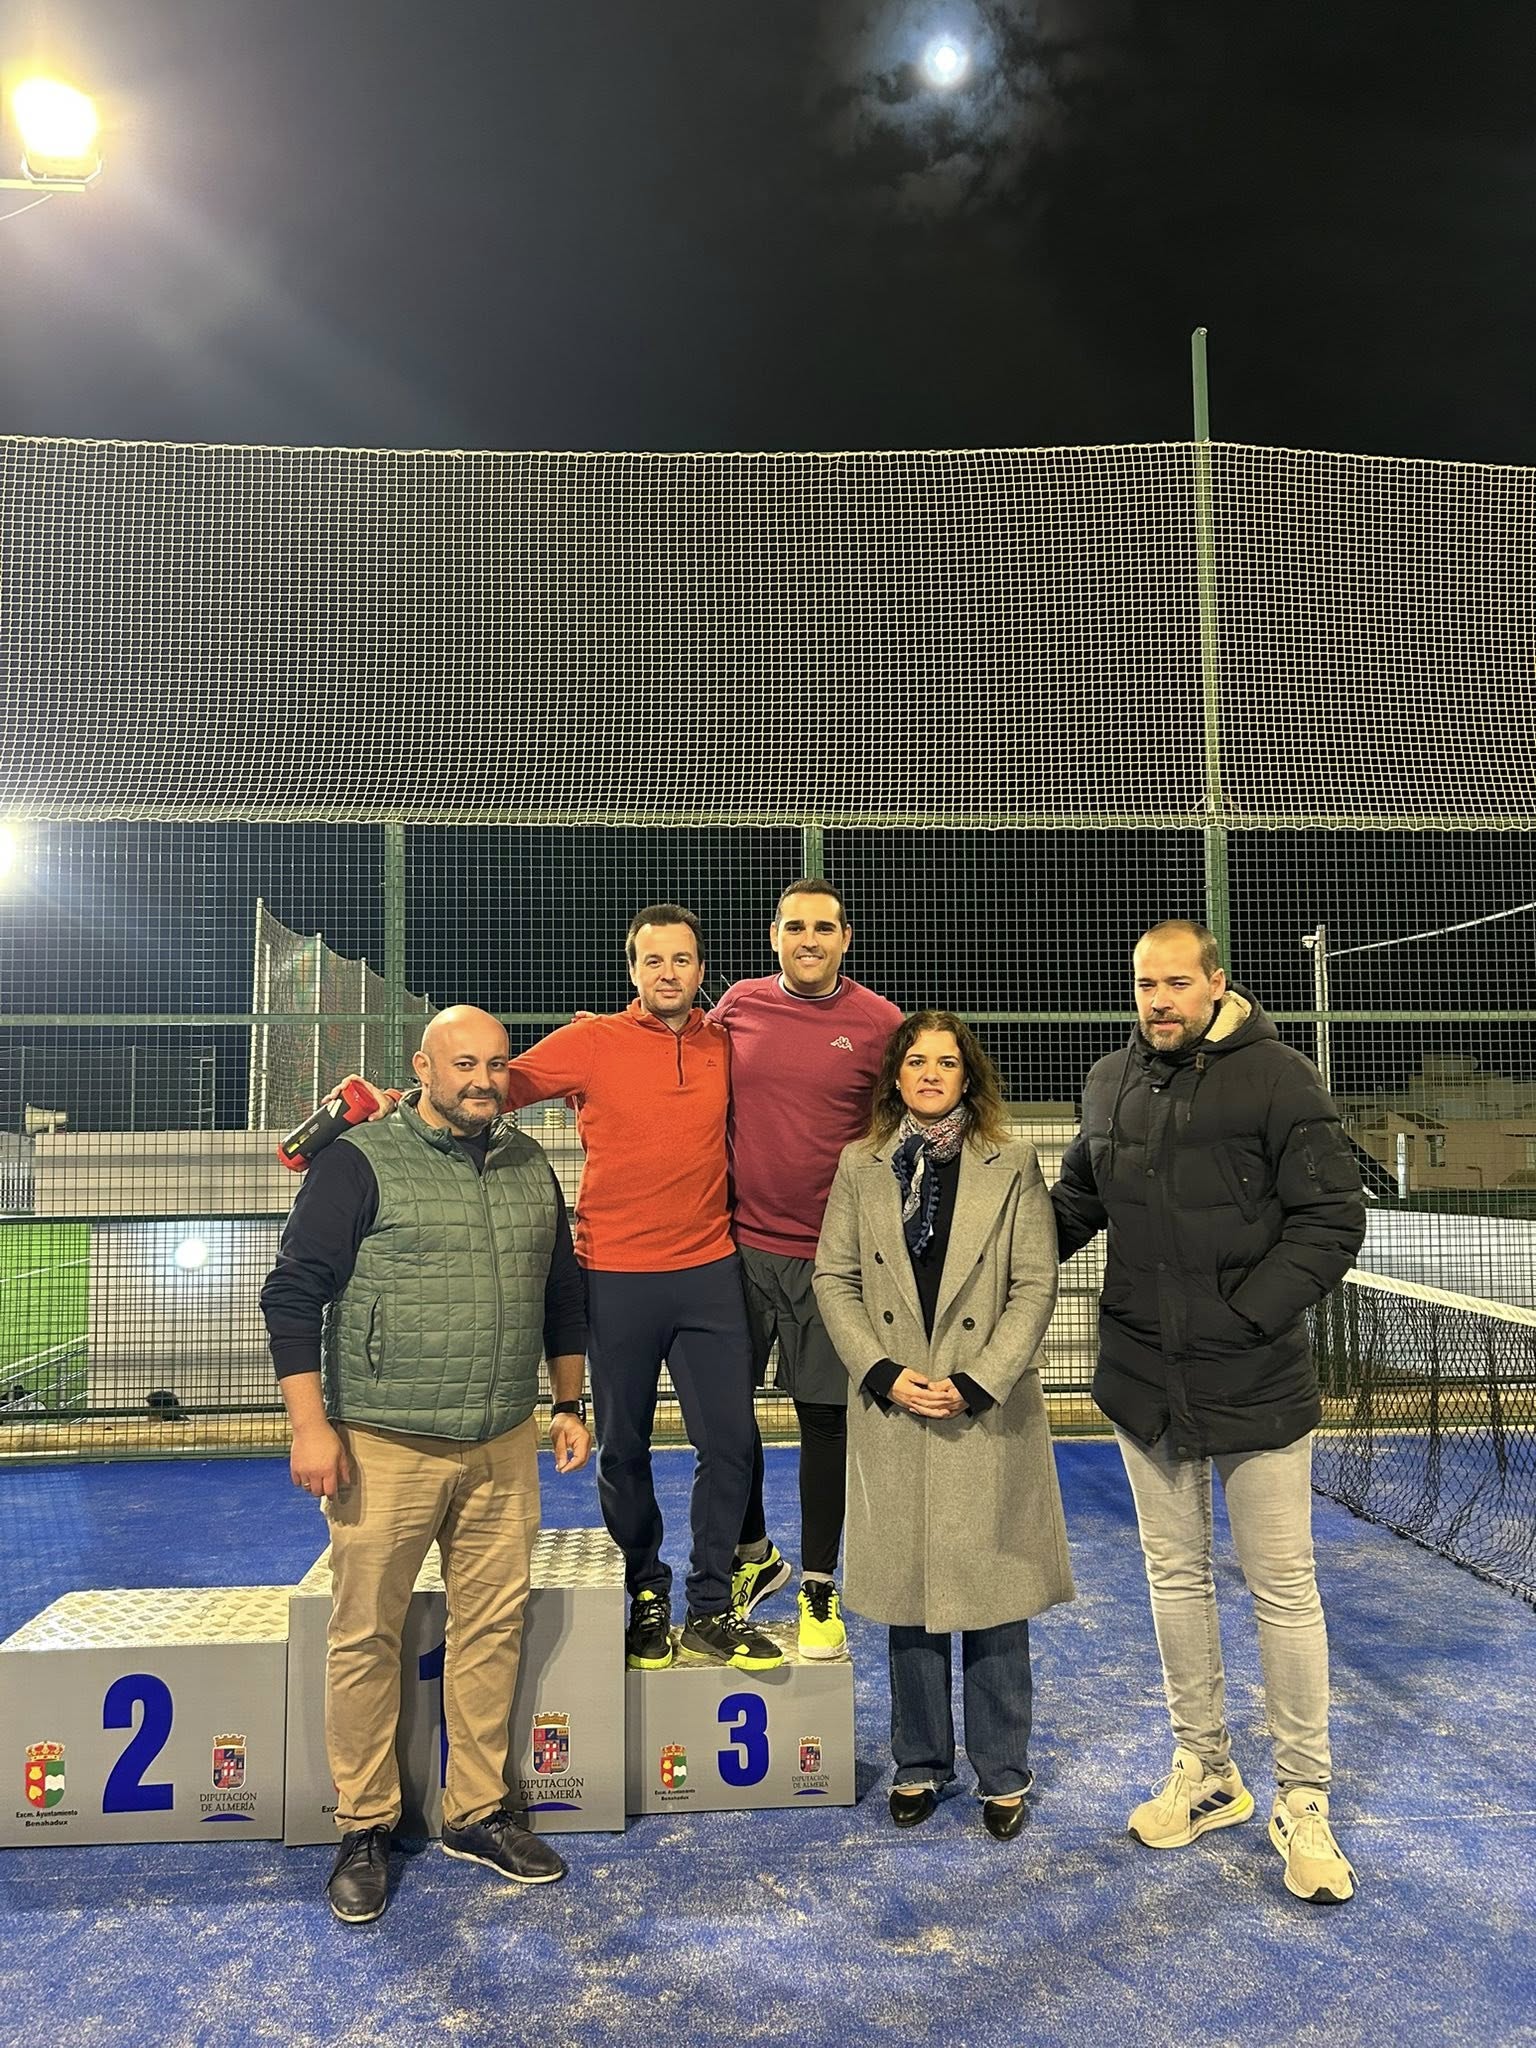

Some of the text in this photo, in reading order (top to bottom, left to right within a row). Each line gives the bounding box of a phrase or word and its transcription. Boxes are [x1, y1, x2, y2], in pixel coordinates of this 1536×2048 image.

[102, 1674, 174, 1814] 2
[717, 1692, 770, 1787] 3
[518, 1776, 584, 1789] DIPUTACIÓN
[199, 1790, 257, 1802] DIPUTACIÓN
[520, 1788, 582, 1801] DE ALMERÍA
[201, 1802, 255, 1812] DE ALMERÍA
